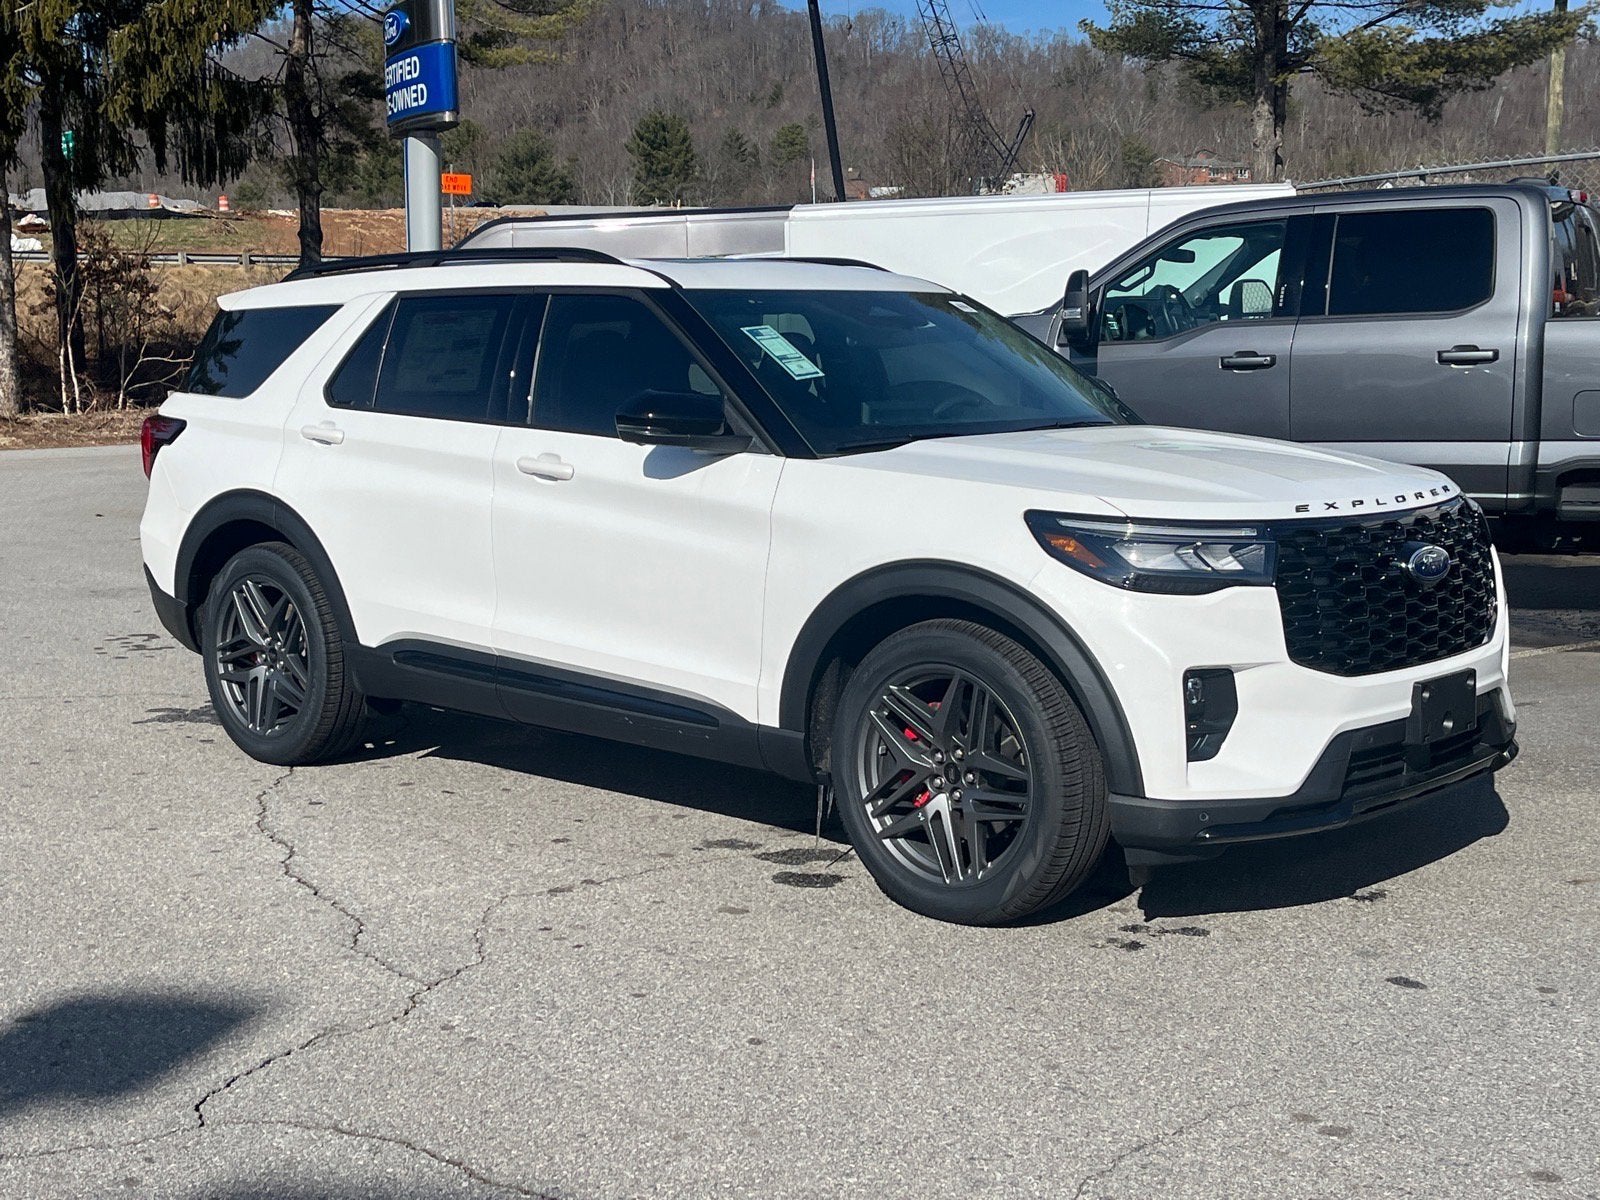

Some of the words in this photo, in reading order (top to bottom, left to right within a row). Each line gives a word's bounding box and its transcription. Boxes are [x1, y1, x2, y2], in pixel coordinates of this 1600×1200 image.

[385, 55, 420, 89] ERTIFIED
[386, 83, 428, 116] E-OWNED
[1294, 484, 1451, 513] EXPLORER
